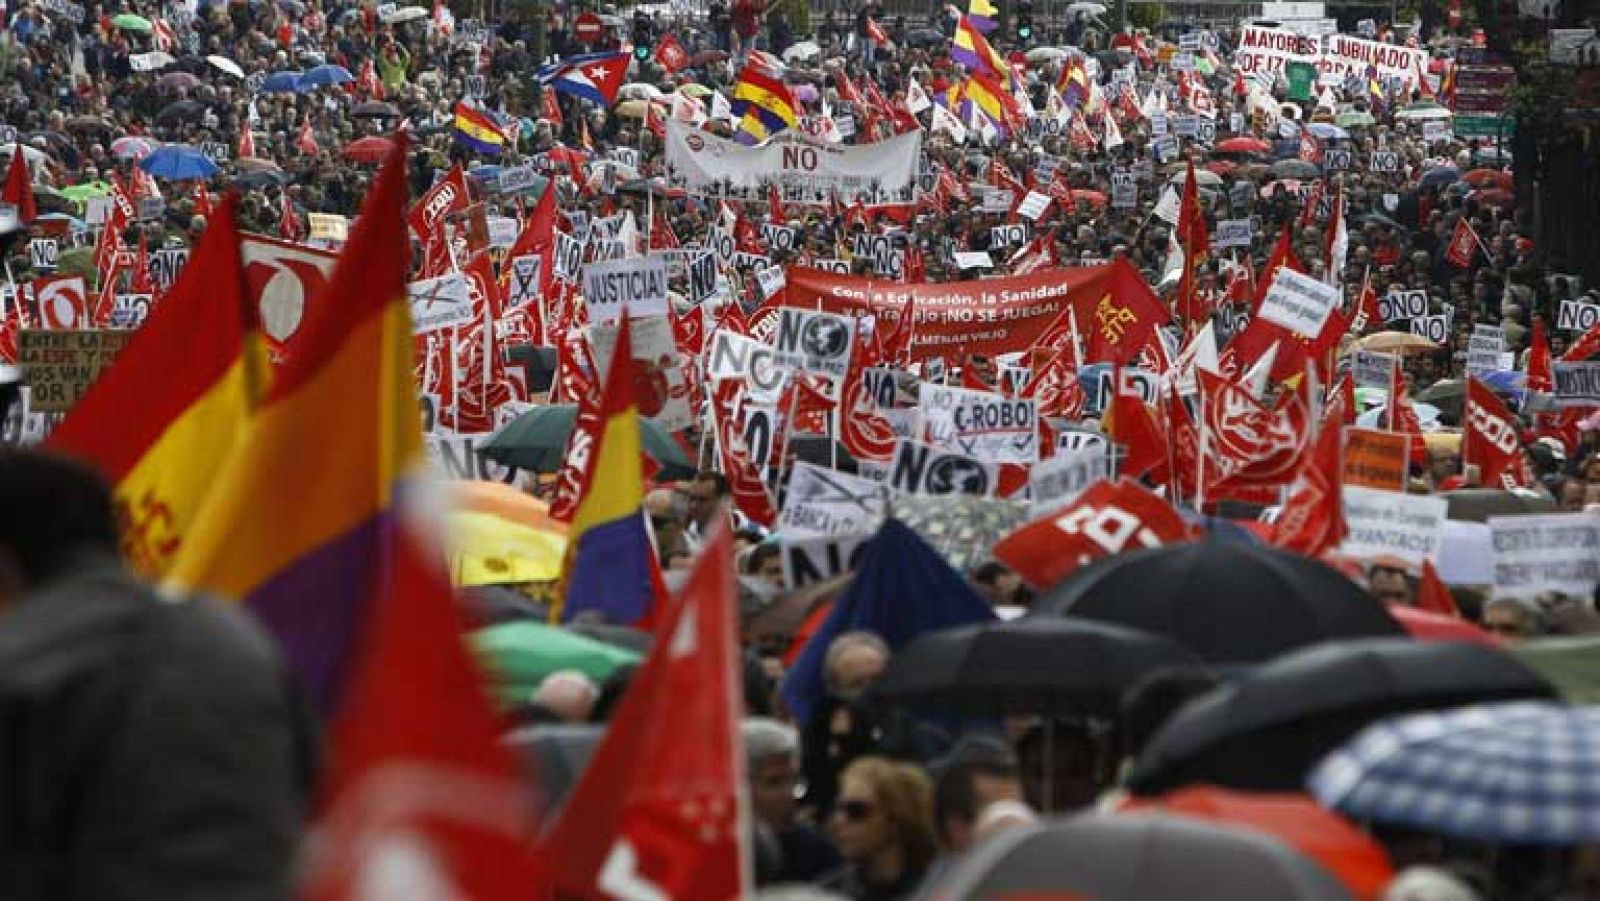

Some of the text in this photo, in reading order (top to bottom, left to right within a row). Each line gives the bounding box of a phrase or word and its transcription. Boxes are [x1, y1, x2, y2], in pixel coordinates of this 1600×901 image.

[1243, 28, 1317, 54] MAYORES
[782, 145, 818, 171] NO
[1372, 153, 1398, 170] NO
[763, 226, 792, 247] NO
[993, 227, 1025, 248] NO
[33, 240, 58, 267] NO
[588, 269, 666, 304] JUSTICIA!
[691, 253, 716, 302] NO
[833, 287, 863, 298] Con
[1001, 283, 1067, 304] Sanidad
[1391, 293, 1425, 317] NO
[976, 308, 998, 322] SE
[1562, 302, 1597, 330] NO
[1413, 317, 1444, 343] NO
